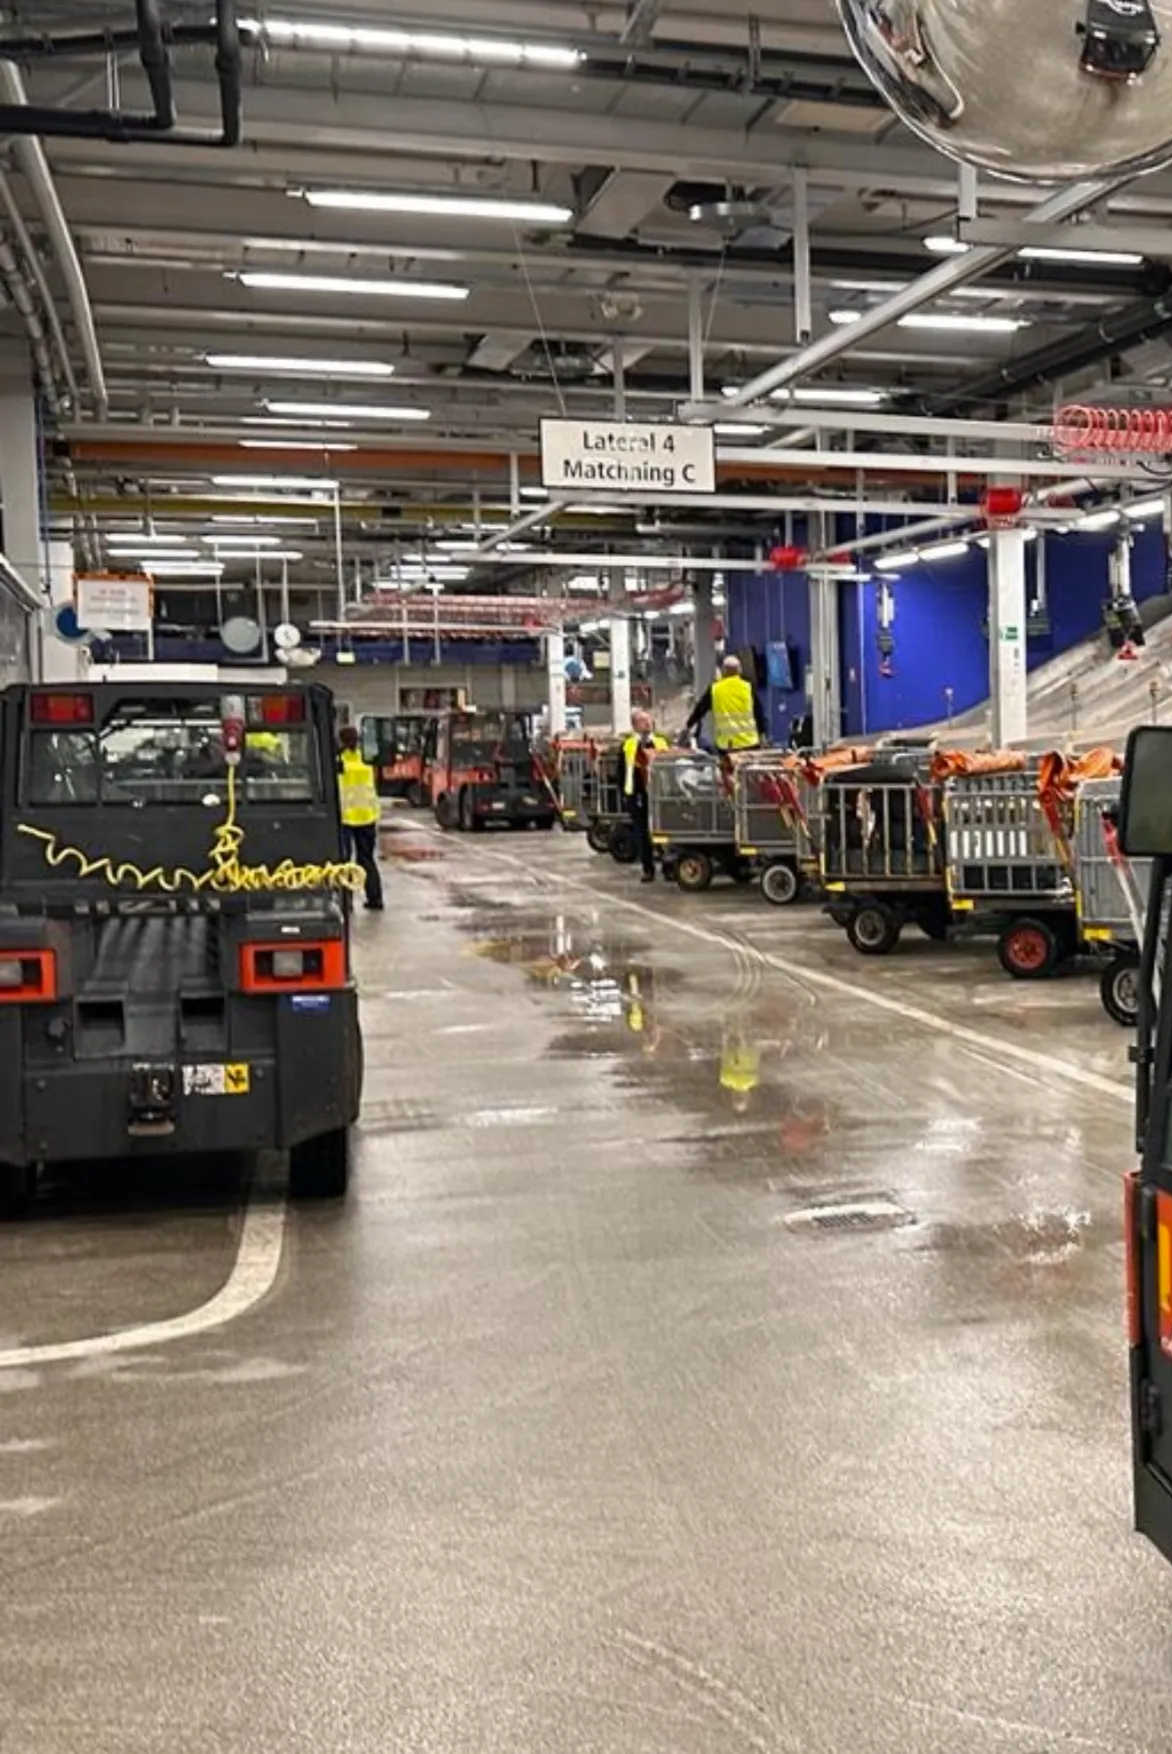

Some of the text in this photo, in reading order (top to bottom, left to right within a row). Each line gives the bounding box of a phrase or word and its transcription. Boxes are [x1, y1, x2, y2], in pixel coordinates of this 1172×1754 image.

[583, 431, 675, 453] Lateral 4
[563, 459, 696, 487] Matchning C
